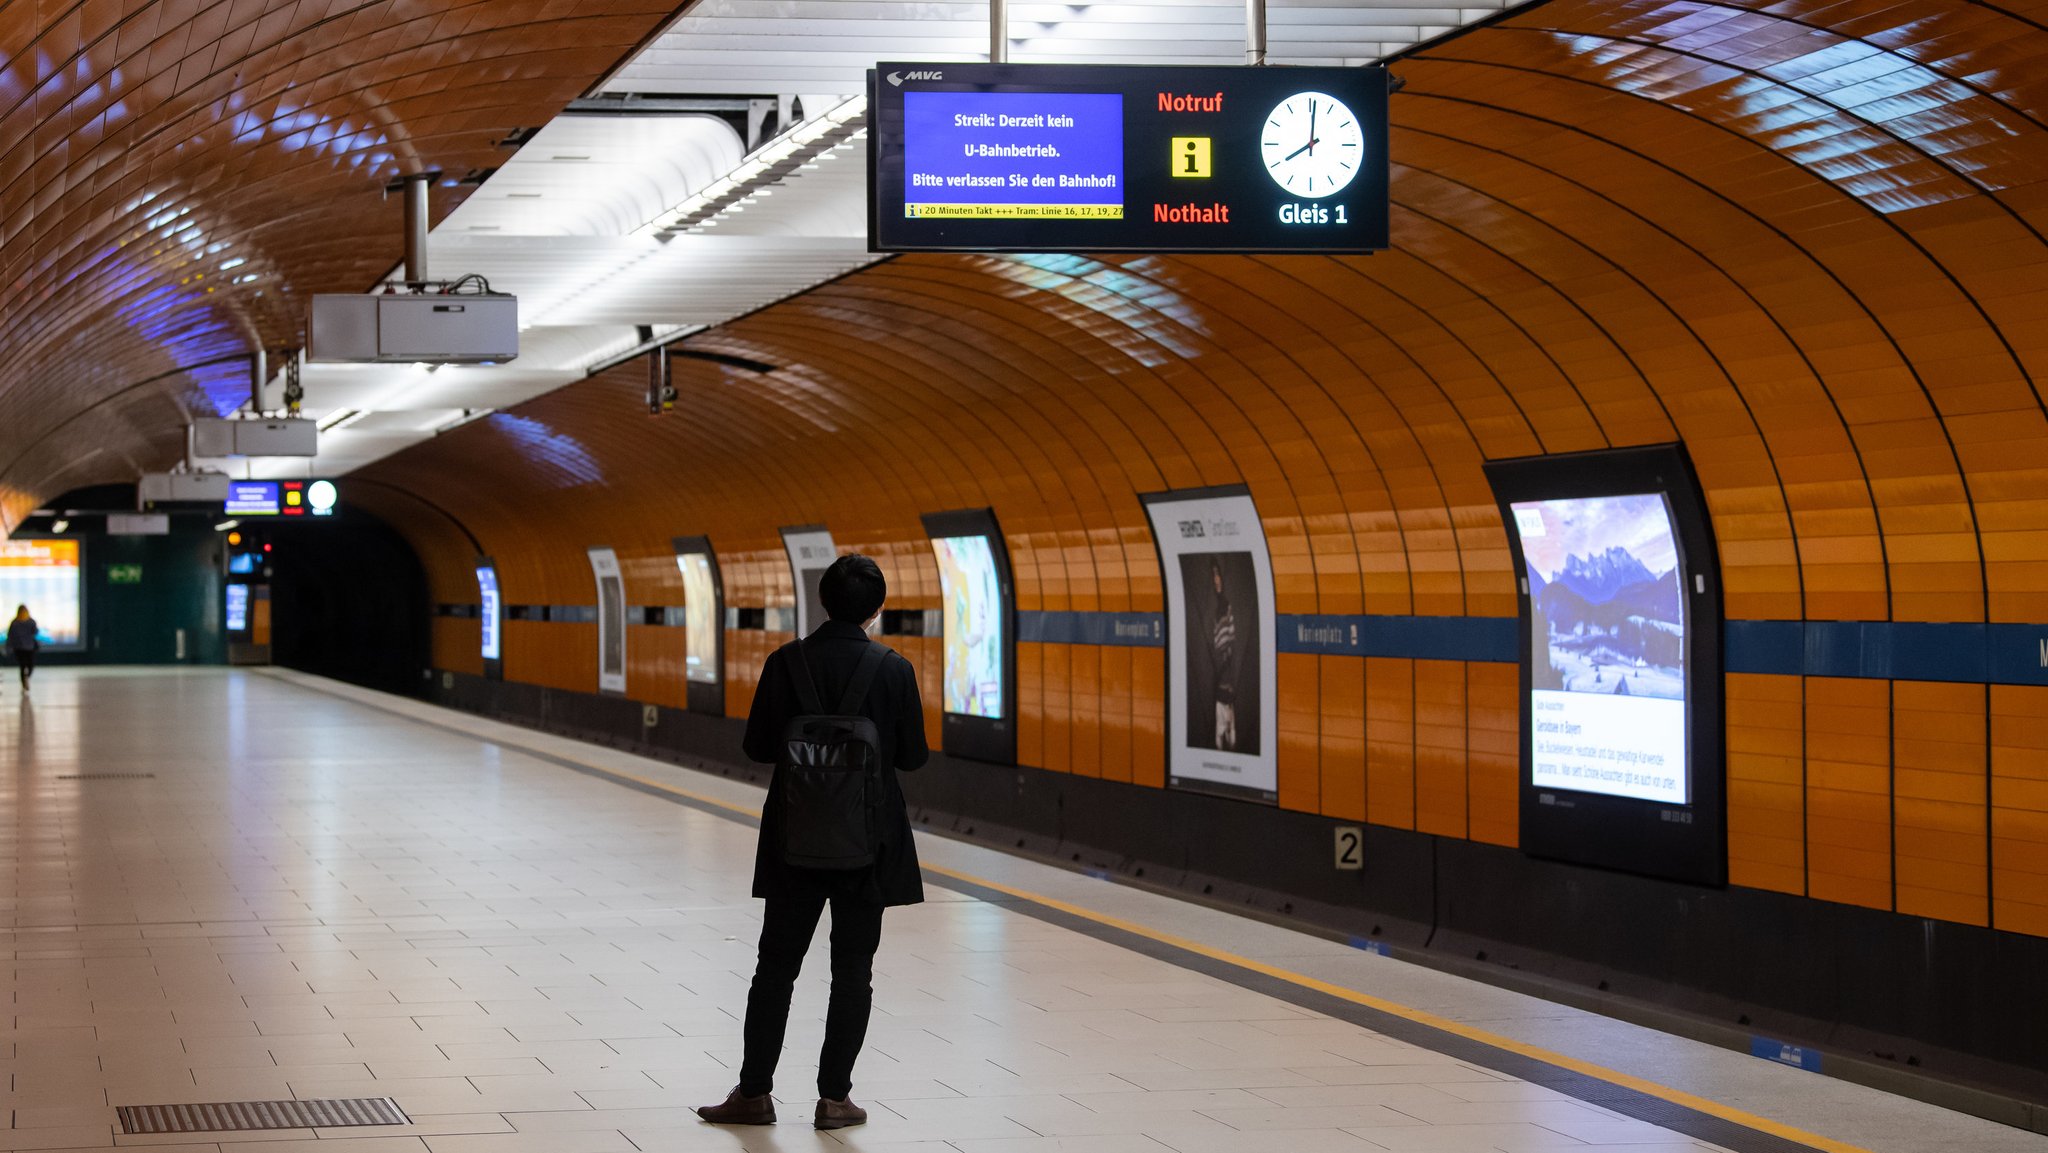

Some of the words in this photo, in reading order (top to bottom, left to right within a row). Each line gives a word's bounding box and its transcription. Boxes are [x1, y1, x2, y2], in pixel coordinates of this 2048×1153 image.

[904, 71, 943, 81] MVG
[1158, 92, 1223, 112] Notruf
[954, 113, 995, 127] Streik:
[999, 113, 1044, 128] Derzeit
[1047, 114, 1074, 128] kein
[964, 143, 1060, 157] U-Bahnbetrieb.
[912, 173, 943, 187] Bitte
[946, 173, 1005, 187] verlassen
[1009, 174, 1029, 187] Sie
[1031, 174, 1055, 187] den
[1059, 174, 1116, 188] Bahnhof!
[925, 206, 936, 215] 20
[938, 206, 973, 215] Minuten
[976, 206, 993, 215] Takt
[1016, 206, 1039, 215] Tram:
[1042, 206, 1062, 215] Linie
[1065, 207, 1078, 216] 16,
[1081, 207, 1094, 216] 17,
[1097, 207, 1110, 216] 19,
[1154, 203, 1229, 223] Nothalt
[1278, 203, 1329, 224] Gleis
[1335, 204, 1348, 224] 1
[1298, 623, 1342, 646] Marienplatz
[1341, 832, 1358, 864] 2
